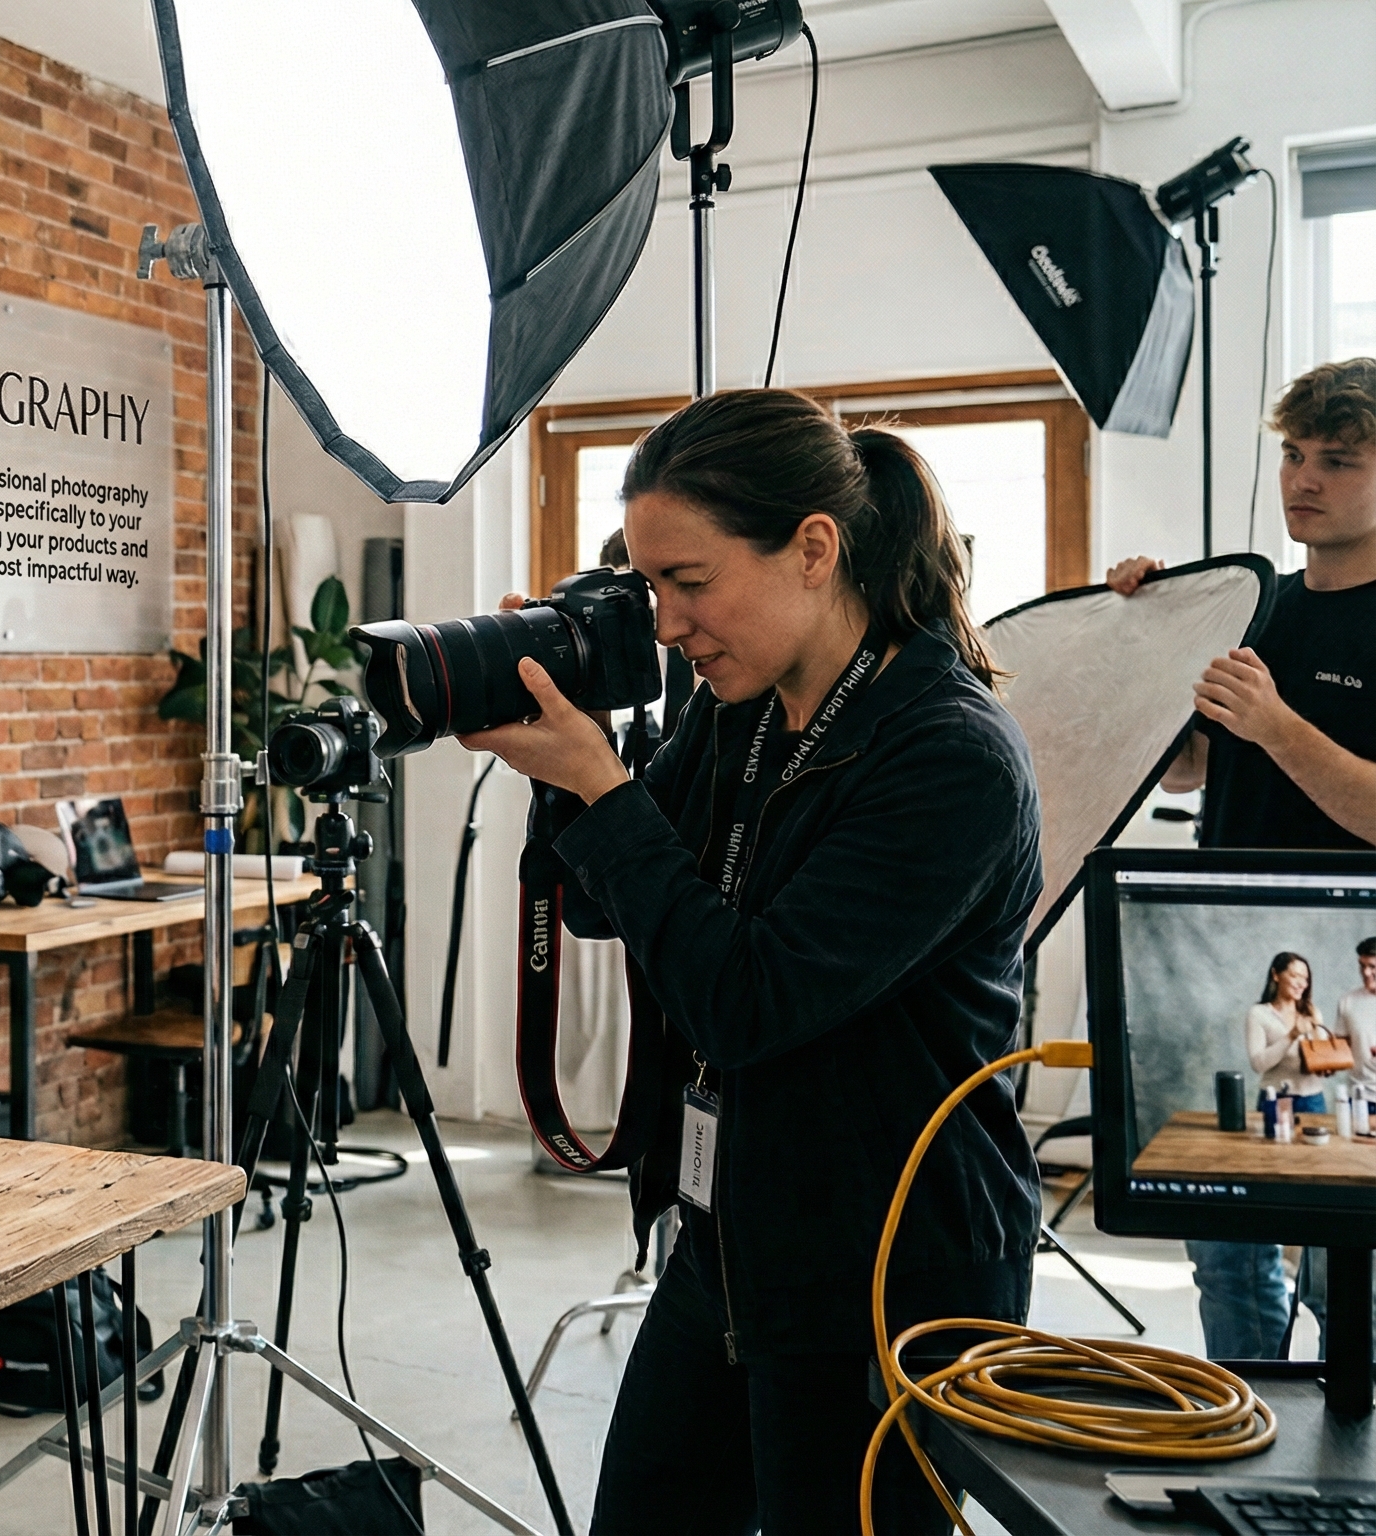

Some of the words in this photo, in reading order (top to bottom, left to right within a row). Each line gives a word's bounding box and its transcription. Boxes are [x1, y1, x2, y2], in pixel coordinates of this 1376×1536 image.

[51, 475, 149, 509] photography
[89, 508, 106, 527] to
[108, 513, 142, 533] your
[6, 531, 44, 552] your
[48, 533, 118, 556] products
[120, 539, 149, 559] and
[27, 556, 102, 584] impactful
[105, 568, 139, 589] way.
[529, 898, 549, 973] Canon
